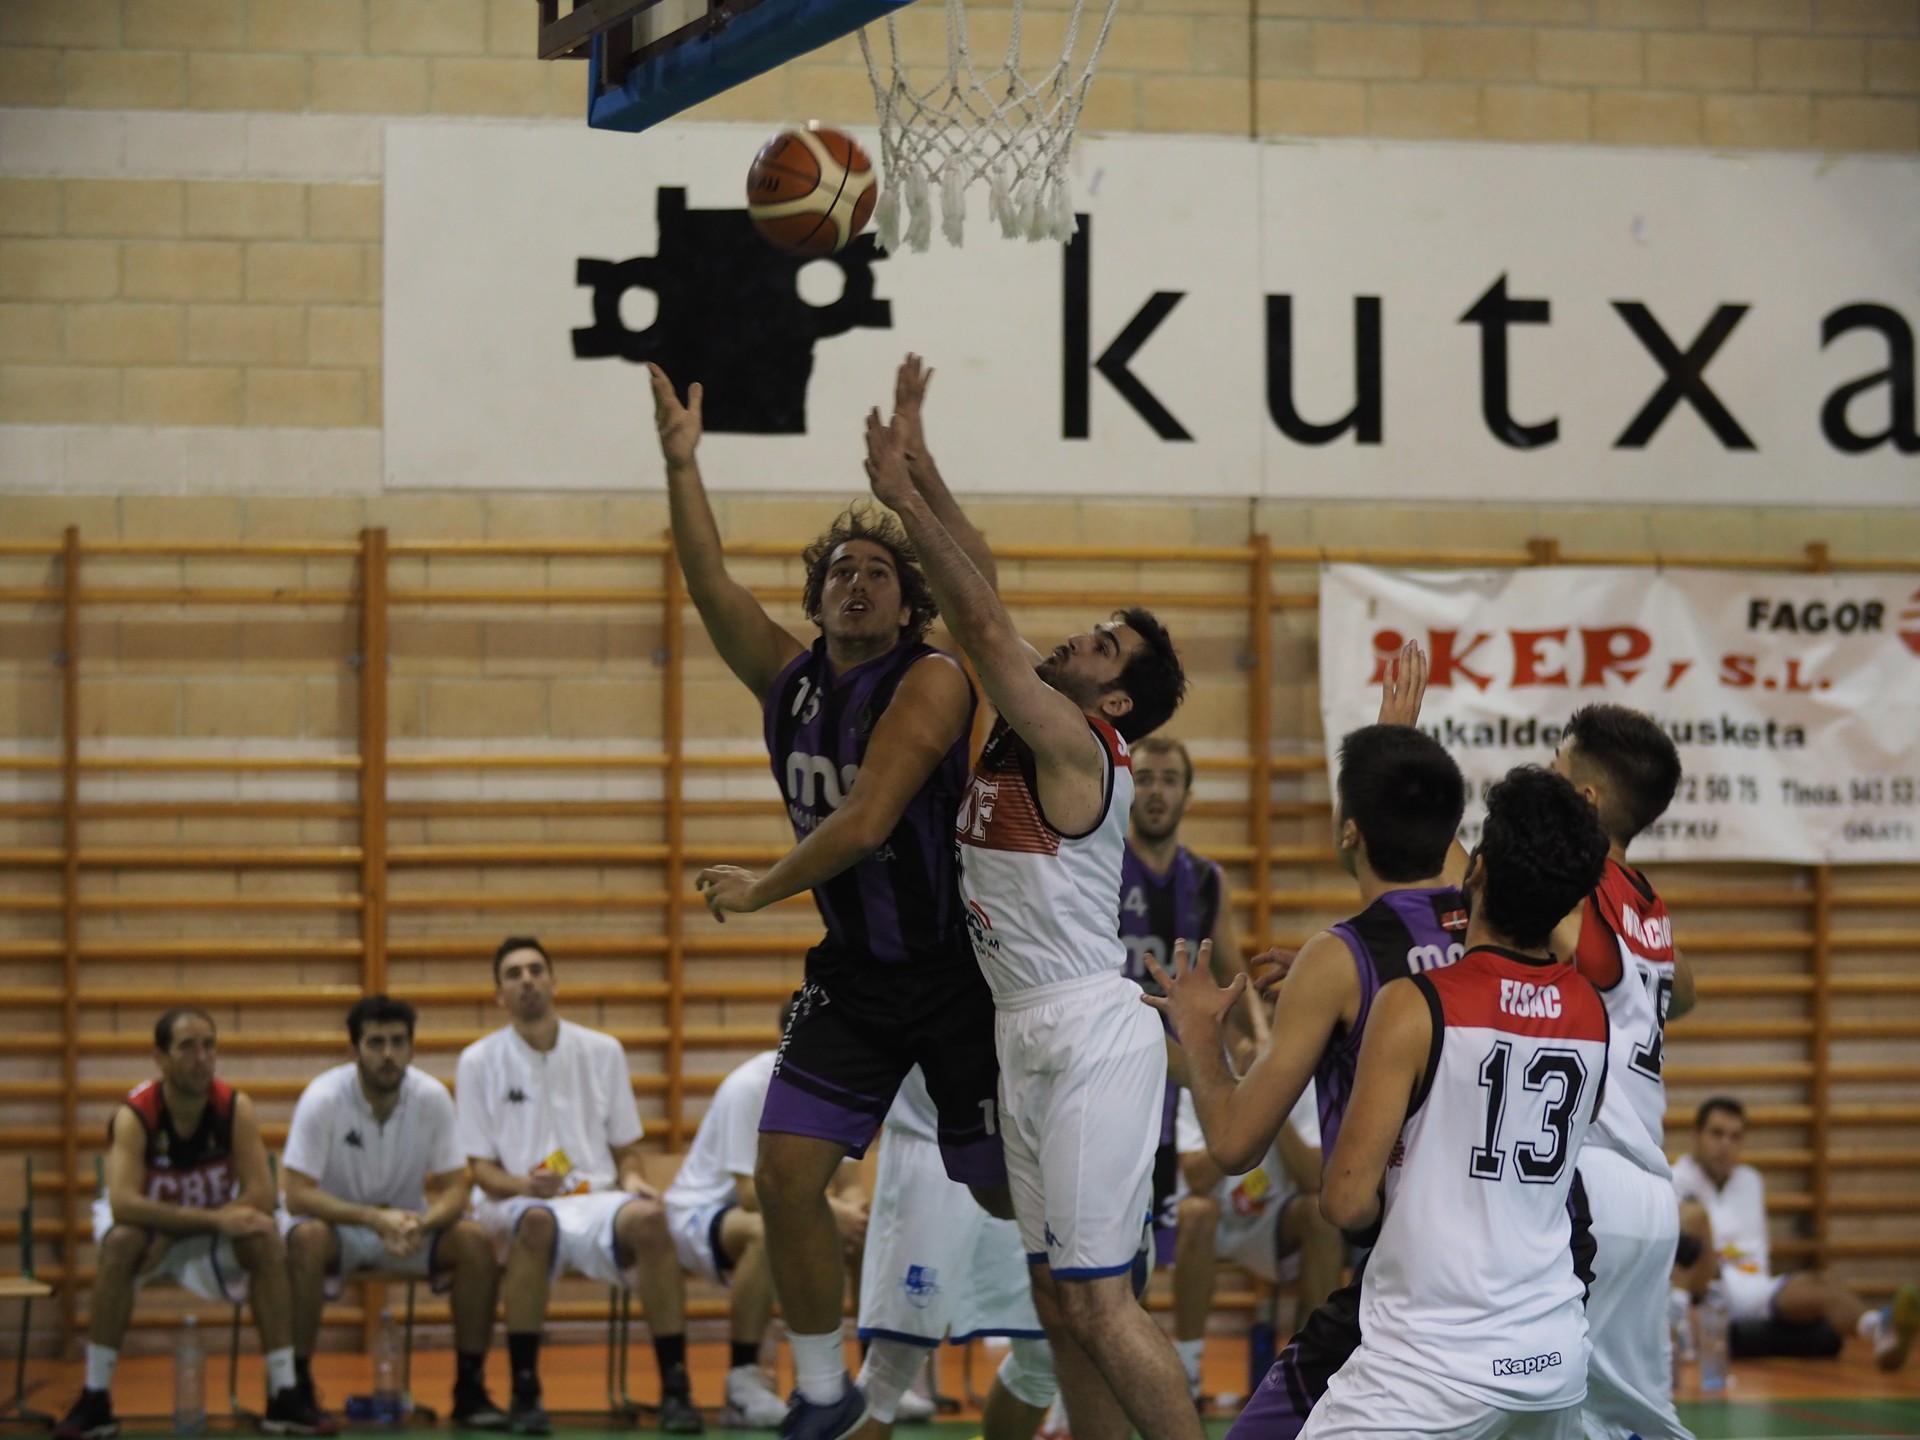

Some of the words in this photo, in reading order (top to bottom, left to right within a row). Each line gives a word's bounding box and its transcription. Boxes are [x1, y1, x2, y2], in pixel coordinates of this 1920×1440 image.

[1061, 212, 1920, 456] kutxa
[1748, 597, 1884, 634] FAGOR
[791, 675, 824, 725] 15
[1500, 978, 1562, 1019] FISAC
[1469, 1040, 1588, 1184] 13
[1492, 1351, 1562, 1377] Kappa
